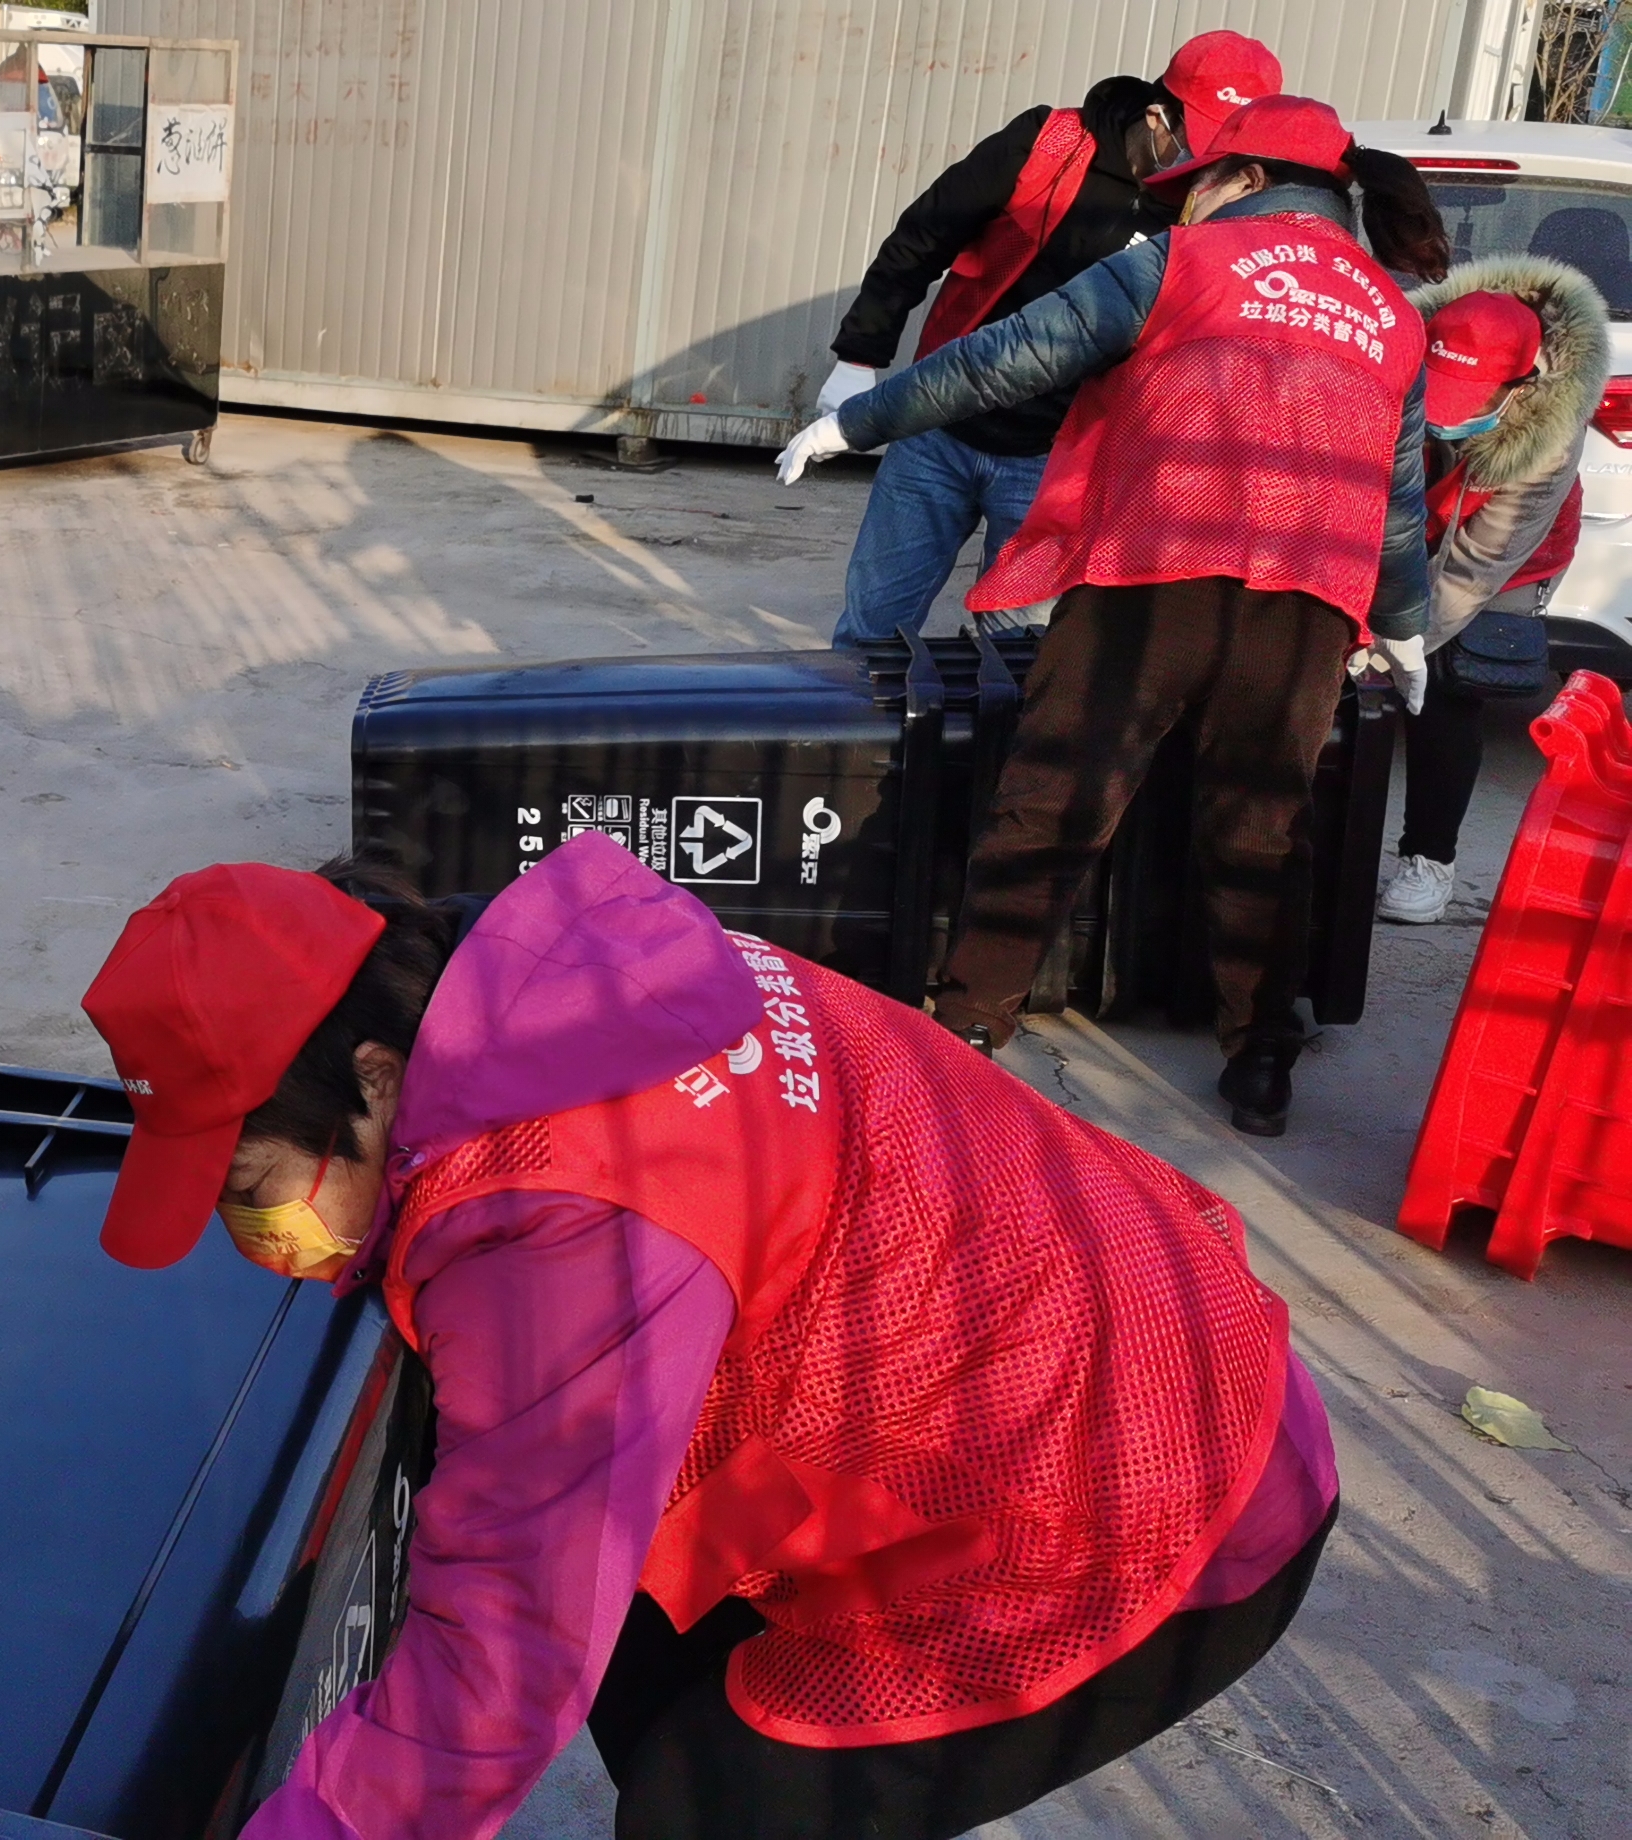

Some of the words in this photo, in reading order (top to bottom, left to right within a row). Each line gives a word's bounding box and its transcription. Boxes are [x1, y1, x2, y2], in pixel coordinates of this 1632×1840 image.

[1230, 244, 1318, 280] 垃圾分类
[1331, 256, 1396, 330] 全民行动
[1288, 287, 1380, 336] 索克环保
[1239, 300, 1385, 364] 垃圾分类督导员
[638, 798, 650, 844] Residual
[651, 808, 668, 872] 其他垃圾
